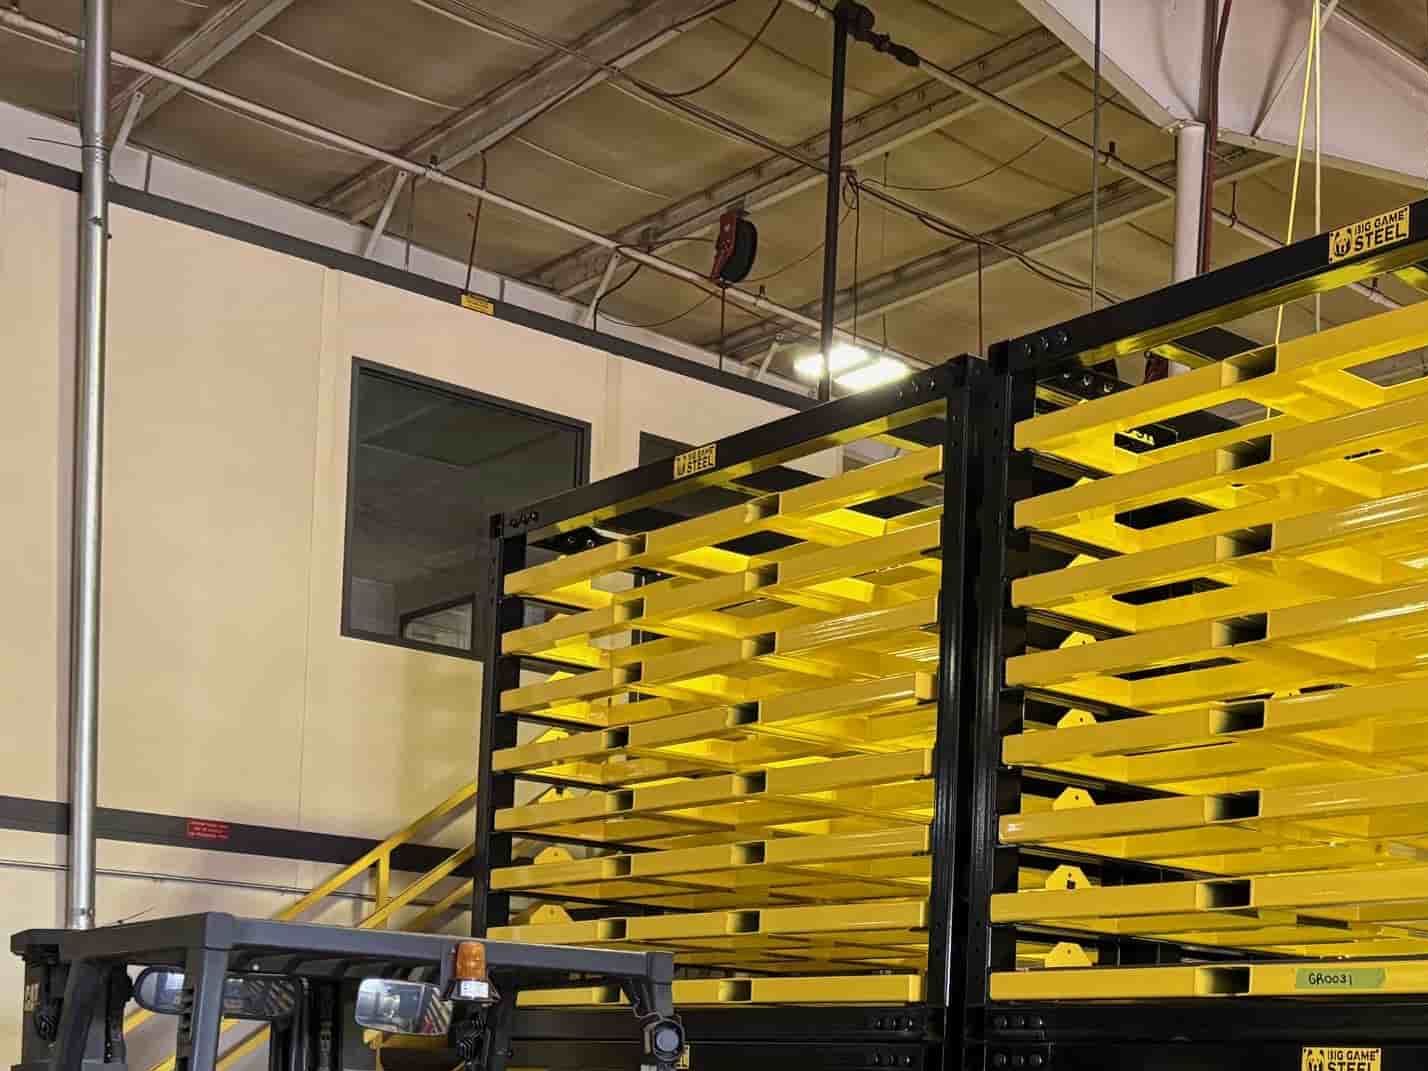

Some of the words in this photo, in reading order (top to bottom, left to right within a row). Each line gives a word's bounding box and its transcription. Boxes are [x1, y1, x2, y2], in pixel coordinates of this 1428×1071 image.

[1374, 208, 1405, 228] GAME
[1354, 222, 1407, 252] STEEL
[1307, 972, 1353, 986] GR0031
[1346, 1050, 1377, 1061] GAME
